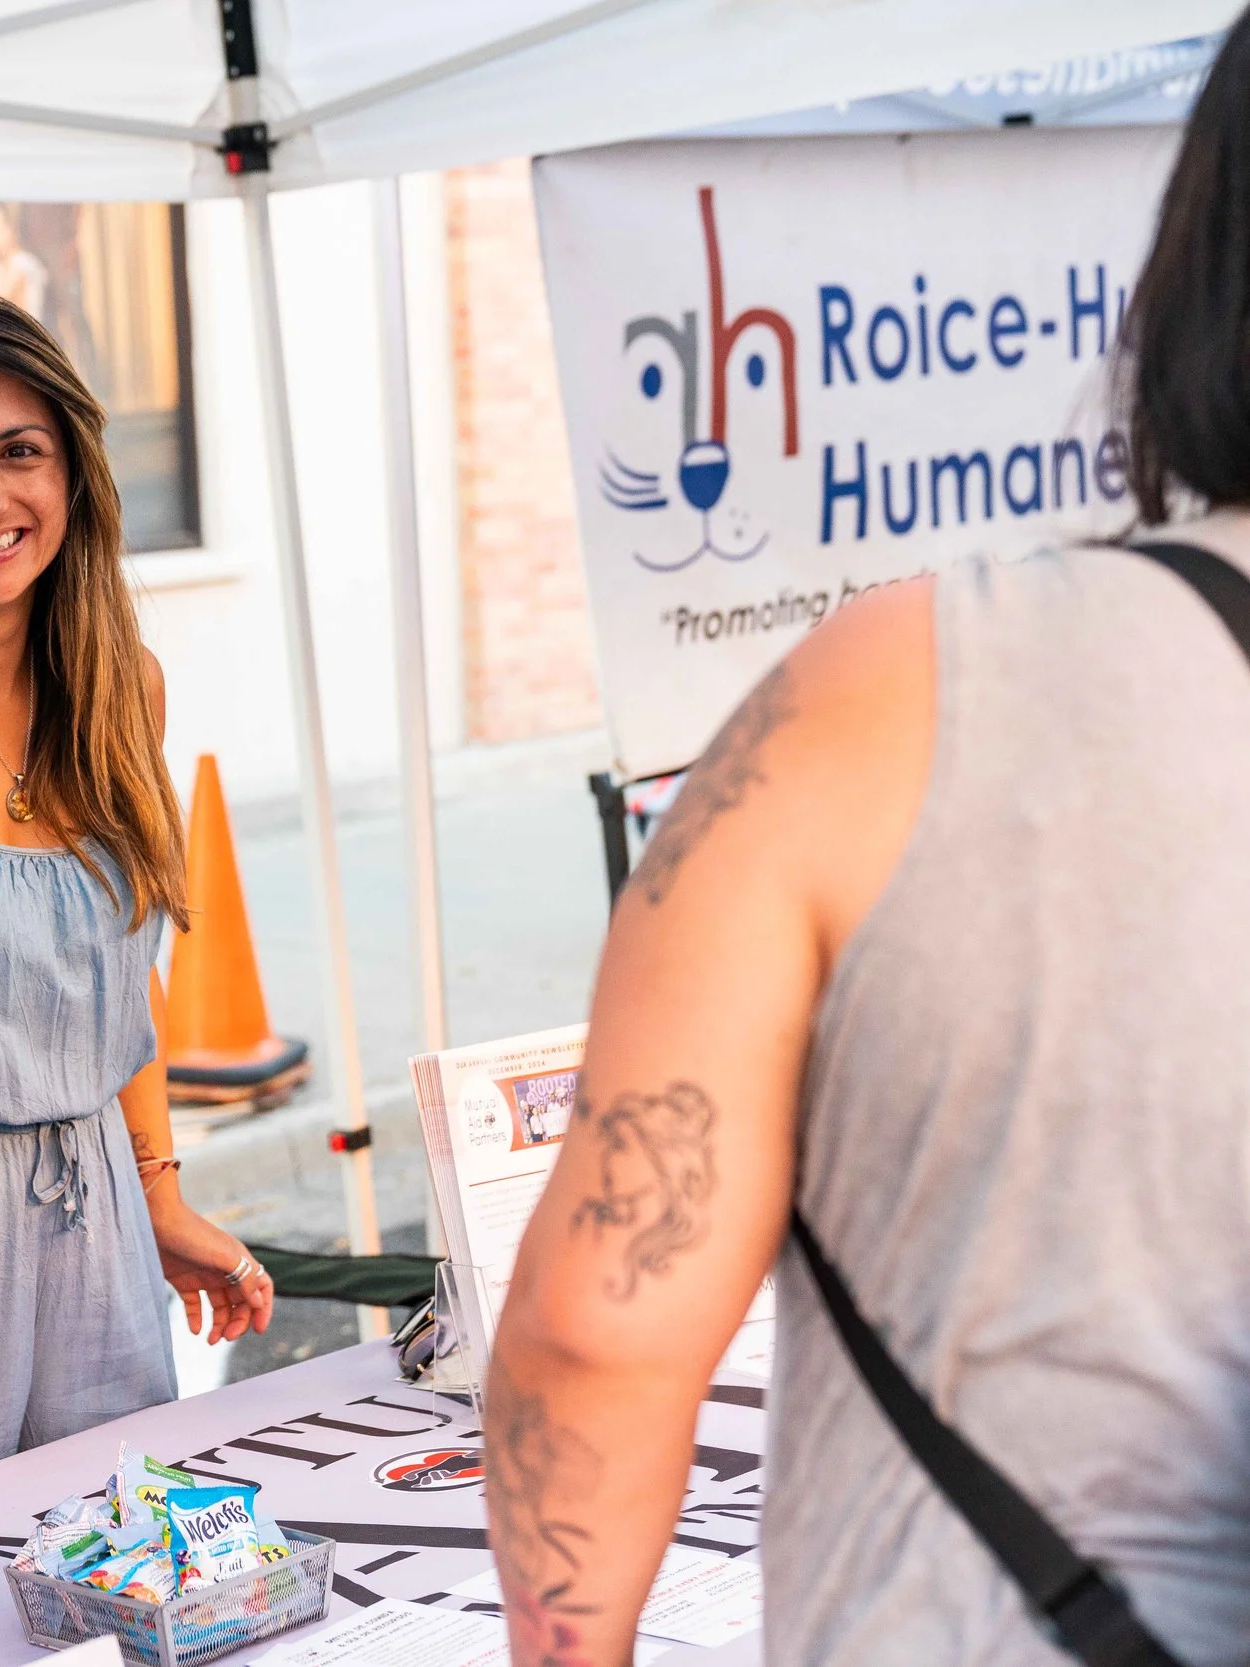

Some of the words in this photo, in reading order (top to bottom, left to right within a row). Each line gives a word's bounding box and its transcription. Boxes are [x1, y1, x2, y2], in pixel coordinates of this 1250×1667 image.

[820, 438, 1130, 544] Humane
[527, 1073, 577, 1096] ROOTED
[179, 1501, 250, 1544] Welch's
